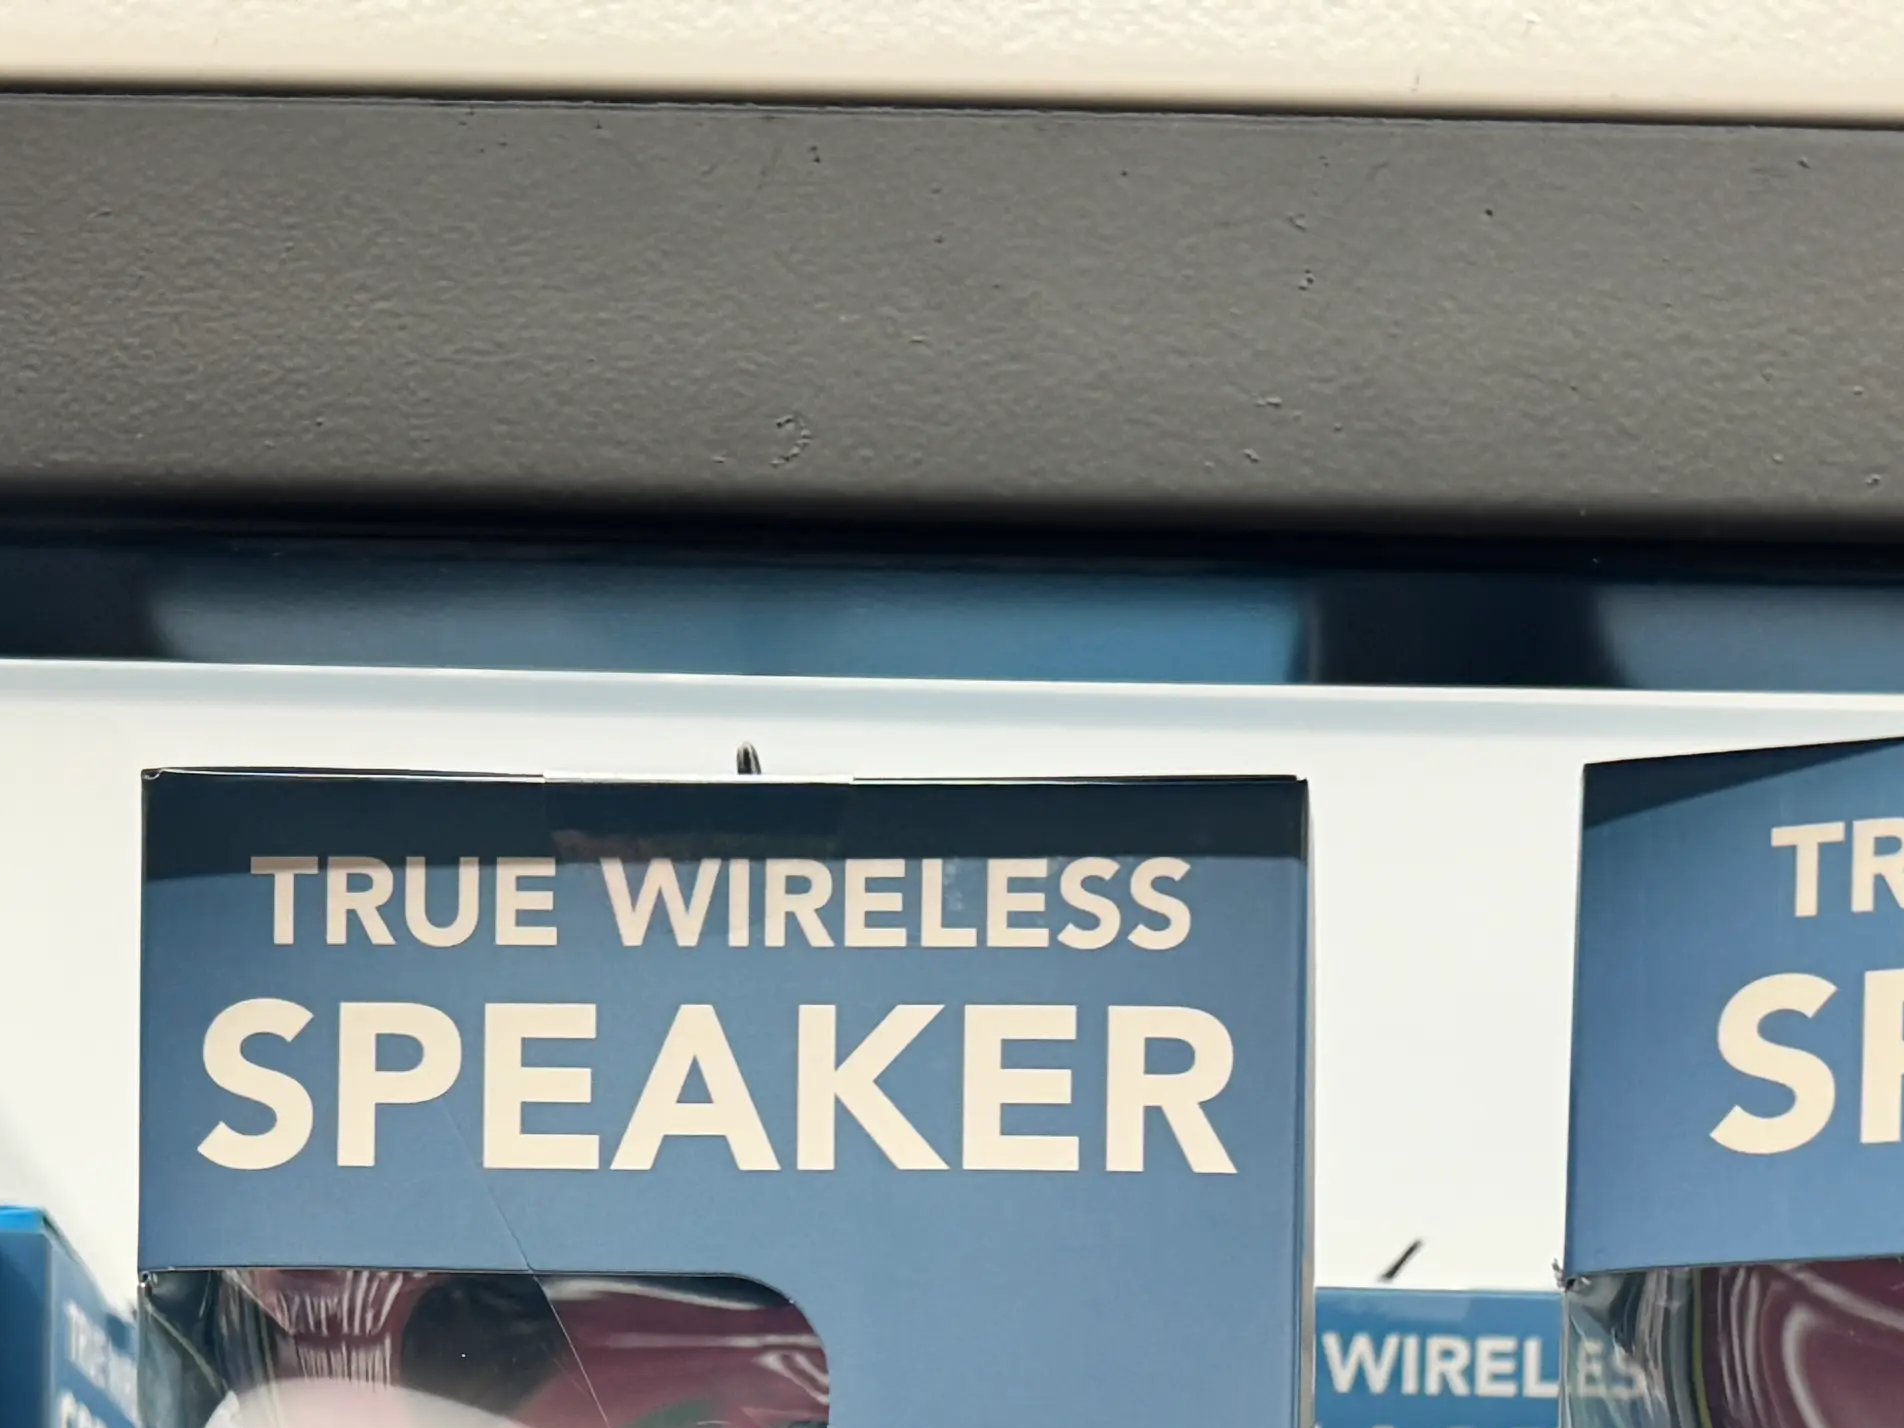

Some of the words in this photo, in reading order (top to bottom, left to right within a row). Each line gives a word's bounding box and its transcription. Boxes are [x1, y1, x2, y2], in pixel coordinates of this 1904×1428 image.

[251, 856, 558, 948] TRUE
[597, 856, 1192, 951] WIRELESS
[196, 997, 1238, 1174] SPEAKER
